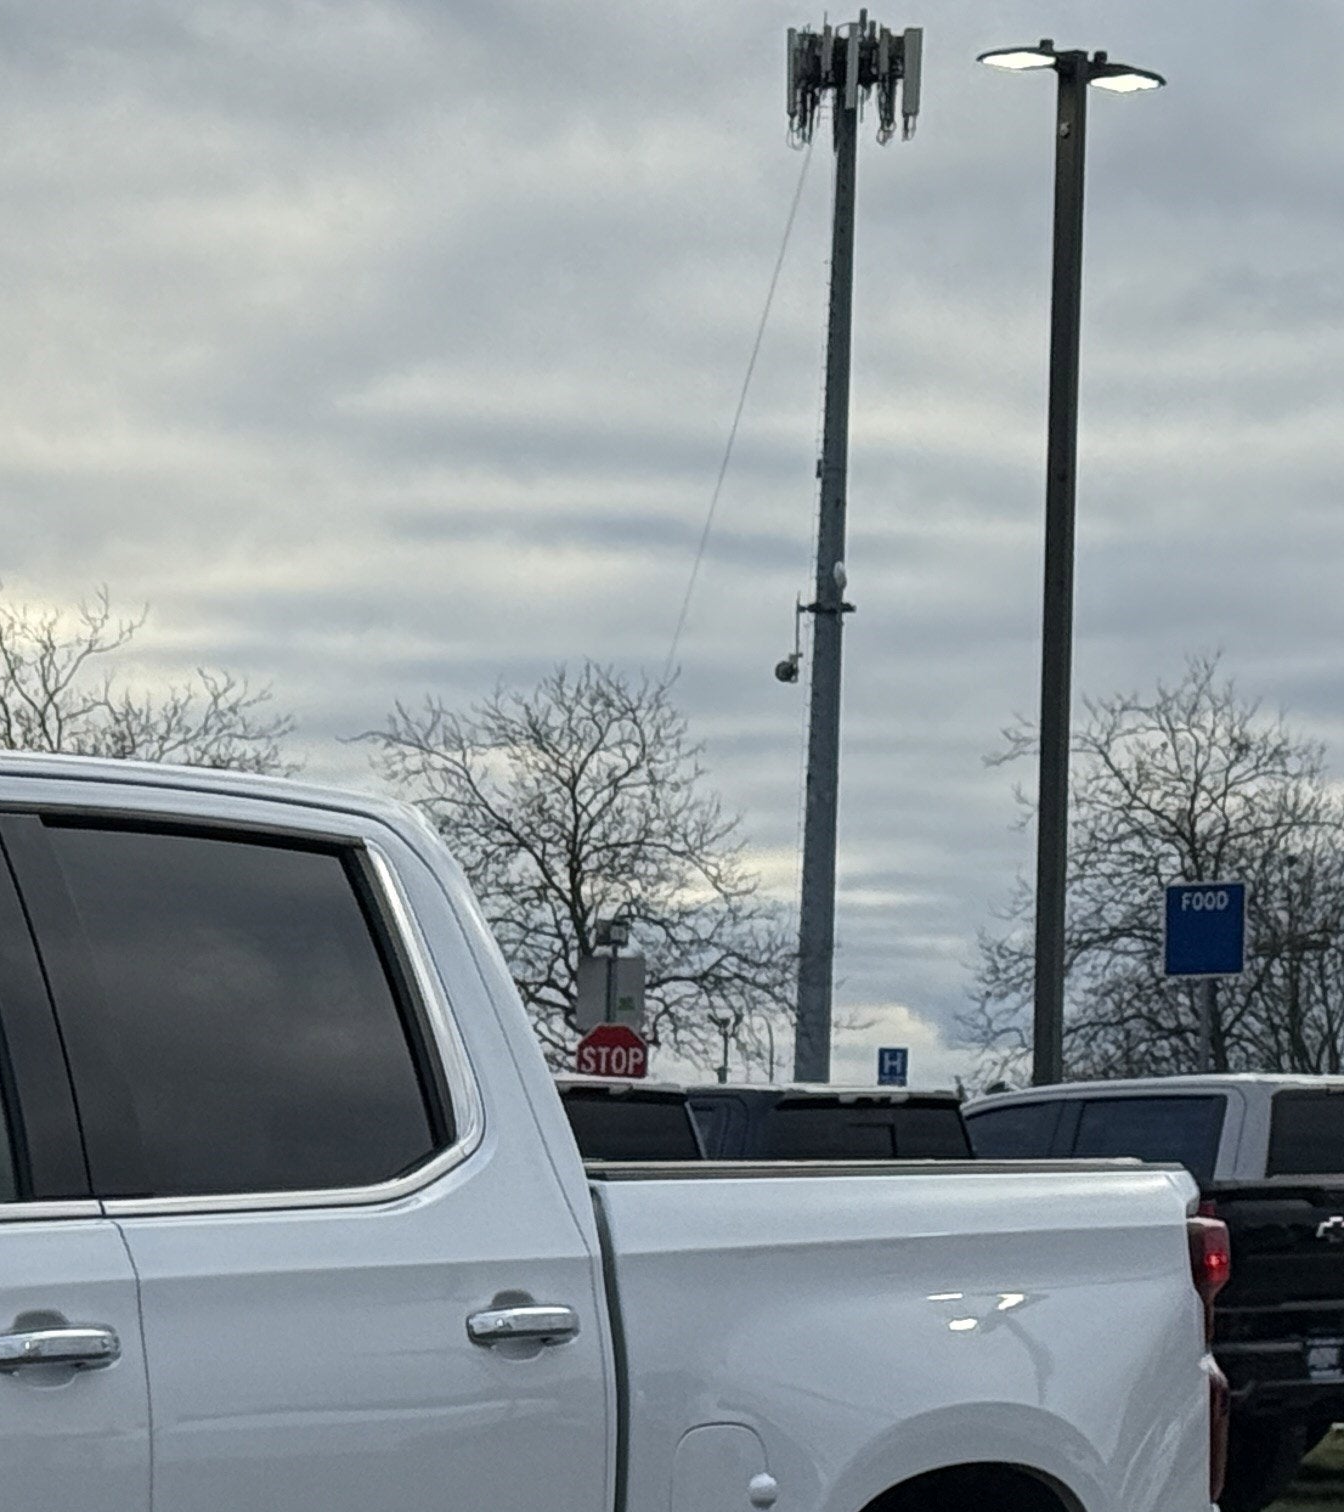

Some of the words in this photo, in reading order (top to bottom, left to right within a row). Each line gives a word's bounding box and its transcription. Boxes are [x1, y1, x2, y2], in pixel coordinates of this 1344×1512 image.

[1181, 890, 1229, 912] FOOD
[580, 1046, 645, 1075] STOP
[883, 1052, 902, 1074] H
